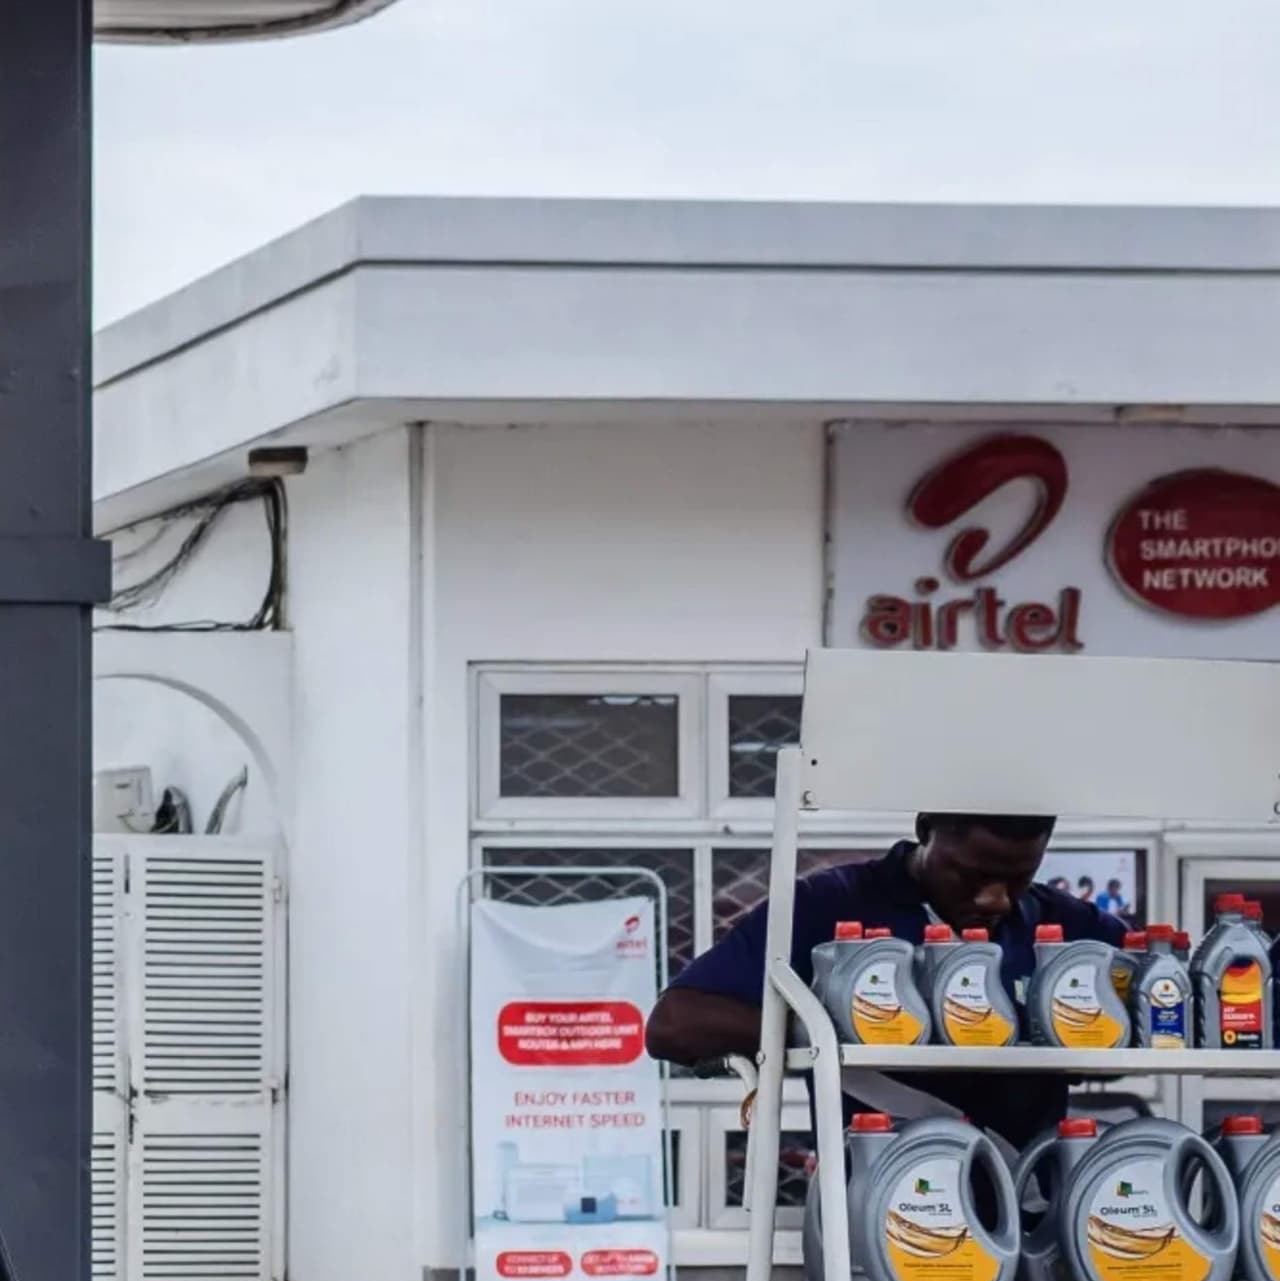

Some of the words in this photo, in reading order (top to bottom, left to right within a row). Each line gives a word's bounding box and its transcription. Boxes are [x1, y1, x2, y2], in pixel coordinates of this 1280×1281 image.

[1138, 509, 1188, 531] THE
[1140, 537, 1280, 561] SMARTPHO
[1142, 567, 1270, 591] NETWORK
[861, 578, 1084, 654] airtel
[514, 1091, 568, 1106] ENJOY
[572, 1090, 636, 1105] FASTER
[505, 1114, 585, 1129] INTERNET
[589, 1112, 646, 1129] SPEED
[1100, 1206, 1139, 1216] Oleum
